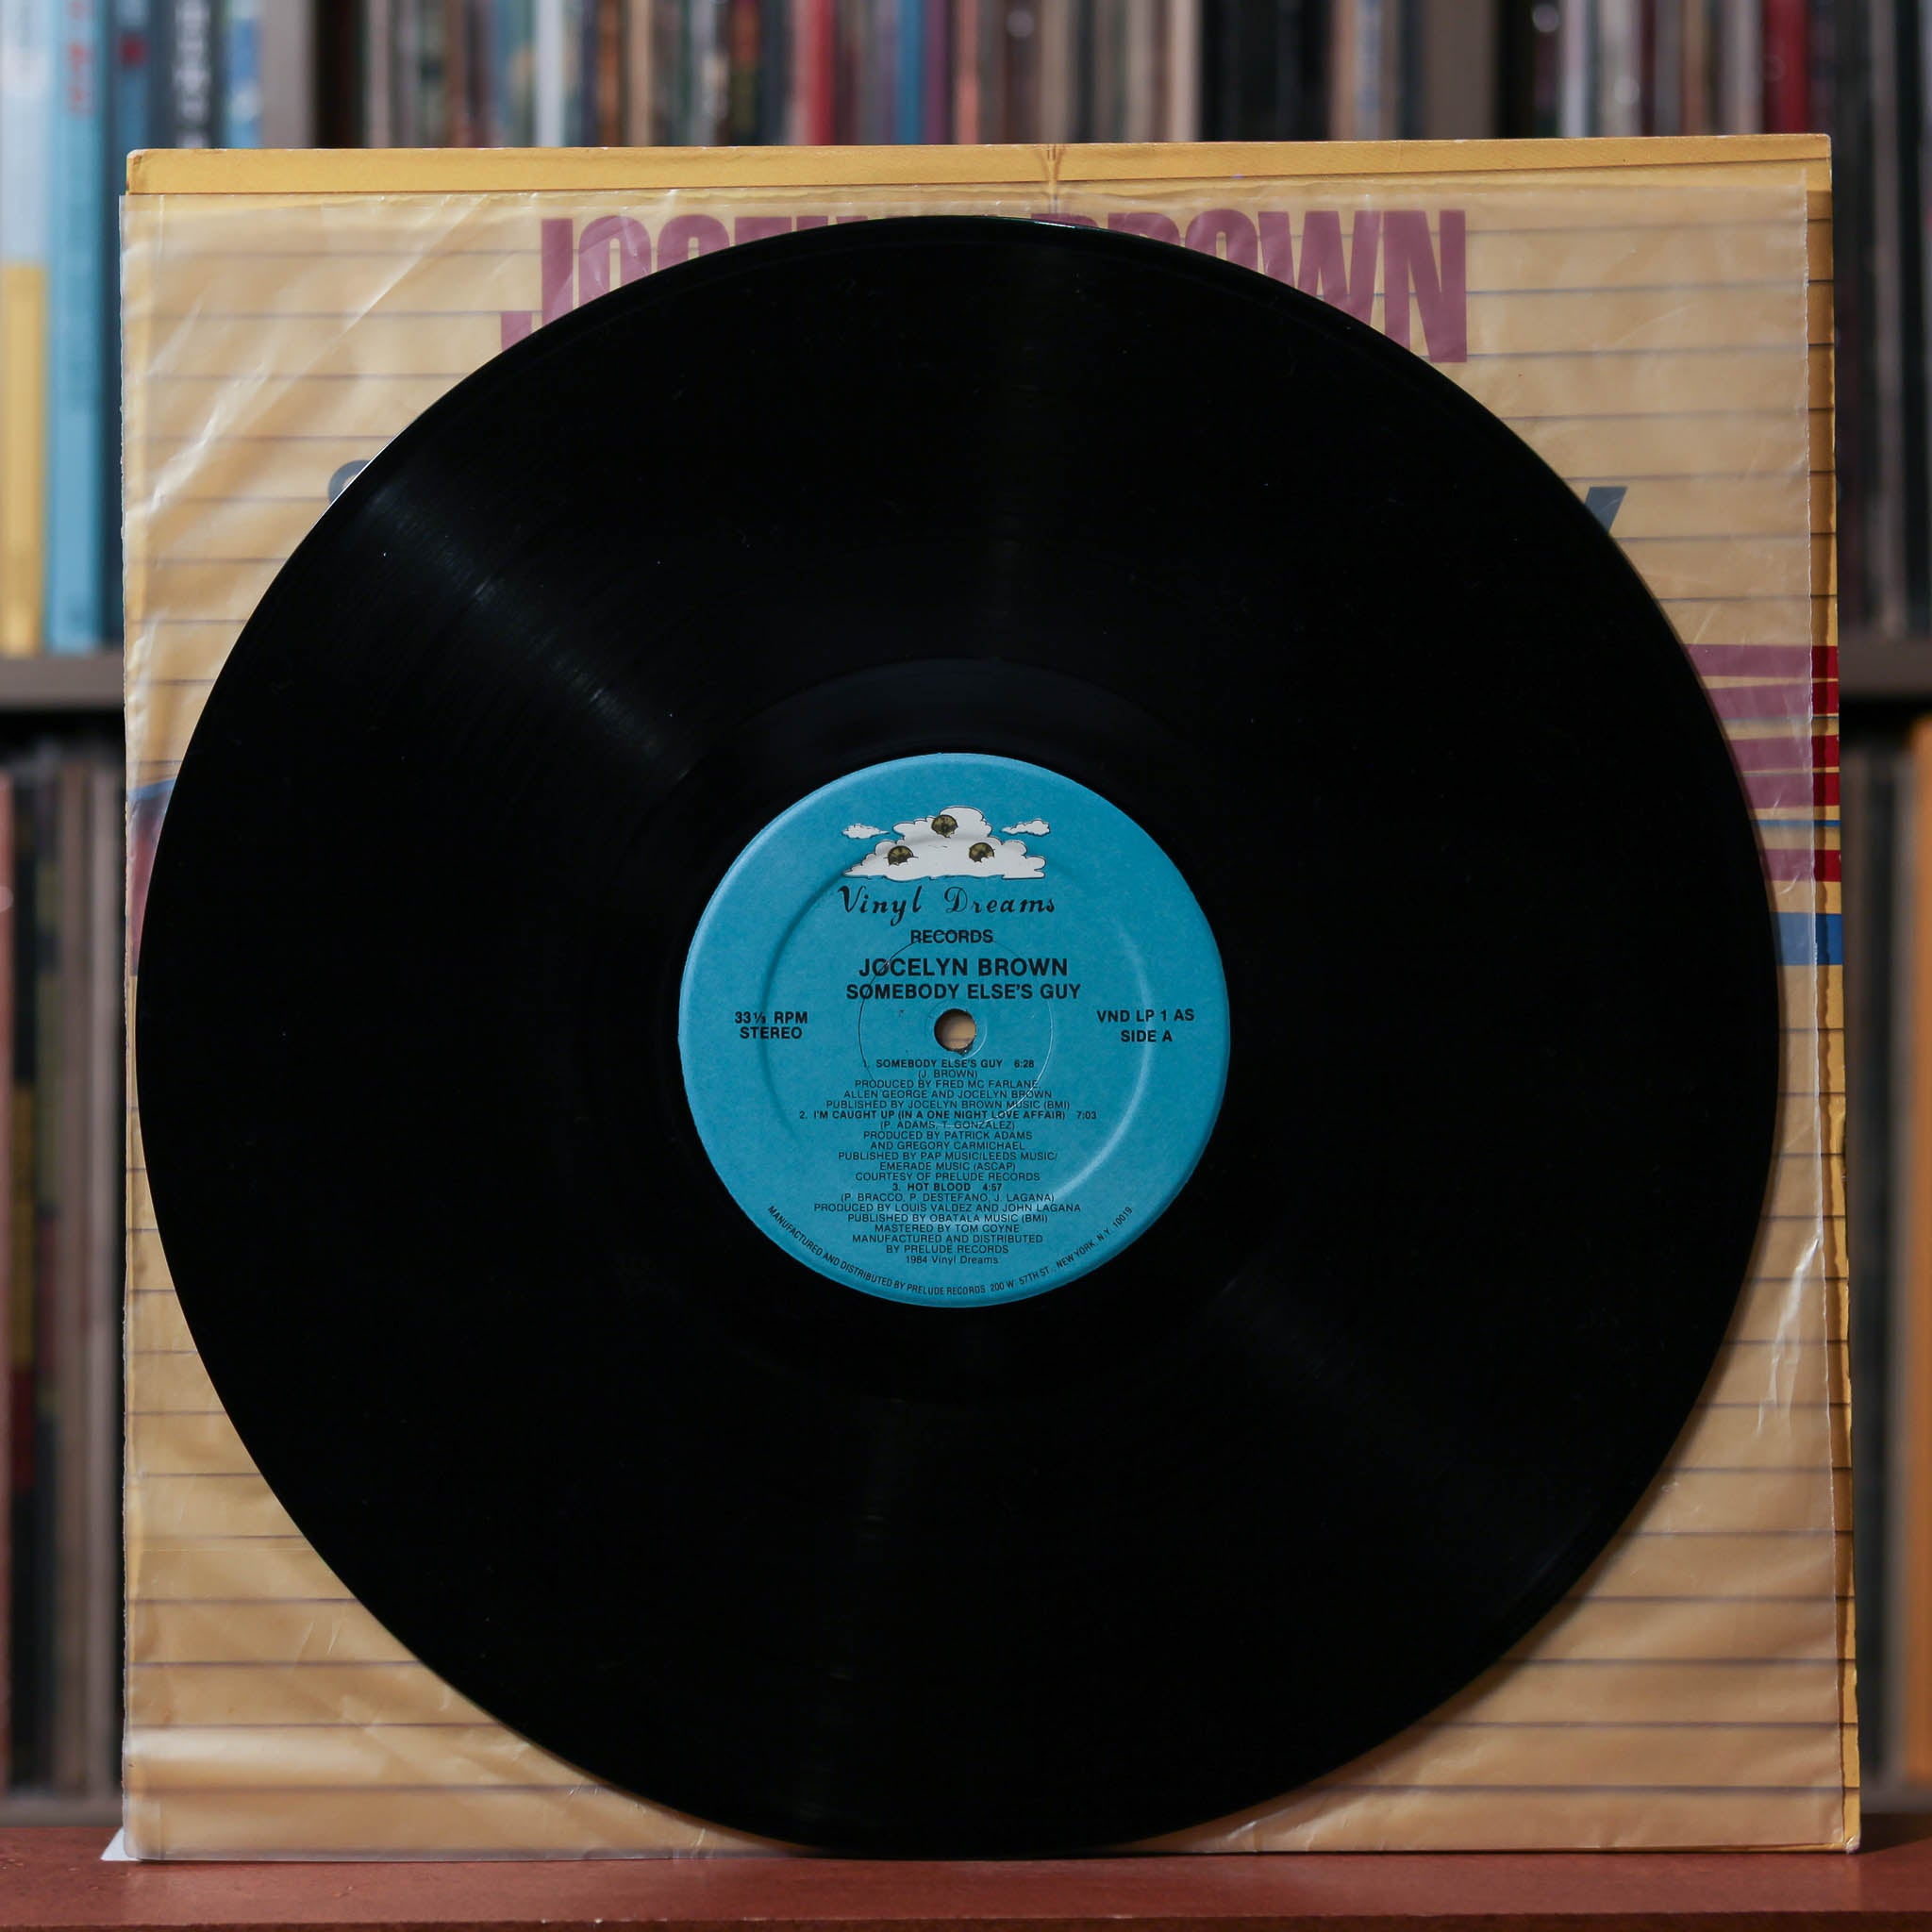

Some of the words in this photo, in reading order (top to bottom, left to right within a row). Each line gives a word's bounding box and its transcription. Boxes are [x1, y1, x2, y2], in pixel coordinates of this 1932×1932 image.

[838, 885, 923, 926] Vinyl
[943, 886, 1056, 914] Dreams
[908, 928, 997, 945] RECORDS
[858, 957, 968, 979] JOCELYN
[977, 957, 1068, 979] BROWN
[845, 983, 960, 1001] SOMEBODY
[967, 983, 1033, 1001] ELSE'S
[1040, 983, 1081, 1001] GUY
[774, 1010, 808, 1025] RPM
[1095, 1009, 1131, 1024] VND
[1136, 1008, 1156, 1024] LP
[1159, 1008, 1167, 1024] 1
[1173, 1008, 1195, 1023] AS
[739, 1025, 803, 1041] STEREO
[1120, 1029, 1158, 1043] SIDE
[1161, 1029, 1174, 1043] A
[875, 1058, 938, 1069] SOMEBODY
[941, 1058, 977, 1069] ELSE'S
[980, 1058, 1004, 1069] GUY
[1013, 1058, 1035, 1069] 6:28
[933, 1069, 978, 1081] BROWN)
[854, 1079, 915, 1090] PRODUCED
[917, 1079, 932, 1090] BY
[935, 1079, 964, 1090] FRED
[967, 1079, 985, 1090] MC
[843, 1090, 878, 1100] ALLEN
[879, 1090, 928, 1100] GEORGE
[930, 1090, 955, 1100] AND
[957, 1090, 1008, 1100] JOCELYN
[1010, 1090, 1052, 1100] BROWN
[825, 1100, 888, 1110] PUBLISHED
[890, 1100, 905, 1110] BY
[907, 1100, 958, 1110] JOCELYN
[961, 1100, 1003, 1110] BROWN
[1006, 1100, 1041, 1110] MUSIC
[1043, 1100, 1071, 1111] (BMI)
[813, 1109, 829, 1121] I'M
[831, 1109, 877, 1121] CAUGHT
[880, 1109, 895, 1121] UP
[897, 1109, 913, 1122] (IN
[915, 1109, 924, 1121] A
[926, 1109, 950, 1121] ONE
[953, 1109, 989, 1121] NIGHT
[991, 1109, 1020, 1121] LOVE
[1022, 1109, 1066, 1122] AFFAIR)
[1075, 1109, 1097, 1121] 7:03
[954, 1121, 1015, 1132] GONZALEZ)
[863, 1131, 924, 1141] PRODUCED
[926, 1131, 941, 1141] BY
[943, 1131, 991, 1141] PATRICK
[993, 1131, 1033, 1141] ADAMS
[870, 1141, 894, 1151] AND
[896, 1141, 950, 1151] GREGORY
[953, 1141, 1025, 1151] CARMICHAEL
[838, 1152, 899, 1161] PUBLISHED
[902, 1152, 917, 1161] BY
[920, 1152, 942, 1161] PAP
[879, 1162, 932, 1172] EMERADE
[935, 1162, 971, 1172] MUSIC
[973, 1162, 1016, 1173] (ASCAP)
[855, 1172, 913, 1182] COURTESY
[916, 1172, 932, 1182] OF
[935, 1172, 985, 1182] PRELUDE
[988, 1172, 1041, 1182] RECORDS
[907, 1182, 930, 1192] HOT
[933, 1182, 972, 1192] BLOOD
[982, 1182, 1003, 1192] 4:57
[1006, 1192, 1055, 1204] LAGANA)
[813, 1203, 874, 1213] PRODUCED
[876, 1203, 891, 1213] BY
[894, 1203, 927, 1213] LOUIS
[929, 1203, 973, 1213] VALDEZ
[974, 1203, 999, 1213] AND
[1001, 1203, 1033, 1213] JOHN
[1036, 1203, 1081, 1213] LAGANA
[847, 1213, 908, 1224] PUBLISHED
[912, 1213, 926, 1224] BY
[929, 1213, 980, 1224] OBATALA
[984, 1213, 1019, 1224] MUSIC
[1021, 1213, 1048, 1224] (BMI)
[874, 1224, 934, 1233] MASTERED
[937, 1224, 951, 1233] BY
[955, 1224, 979, 1233] TOM
[981, 1224, 1020, 1233] COYNE
[852, 1234, 942, 1243] MANUFACTURED
[945, 1234, 970, 1243] AND
[973, 1234, 1043, 1243] DISTRIBUTED
[768, 1206, 824, 1257] MANUFACTURED
[823, 1253, 841, 1266] AND
[840, 1260, 892, 1288] DISTRIBUTED
[893, 1278, 906, 1289] BY
[907, 1283, 945, 1295] PRELUDE
[946, 1285, 986, 1295] RECORDS
[990, 1283, 1005, 1292] 200
[1057, 1253, 1074, 1269] NEW
[1112, 1207, 1133, 1227] 10019
[886, 1244, 901, 1255] BY
[904, 1244, 953, 1255] PRELUDE
[957, 1244, 1009, 1255] RECORDS
[906, 1256, 928, 1265] 1984
[930, 1256, 957, 1267] Vinyl
[959, 1256, 999, 1265] Dreams
